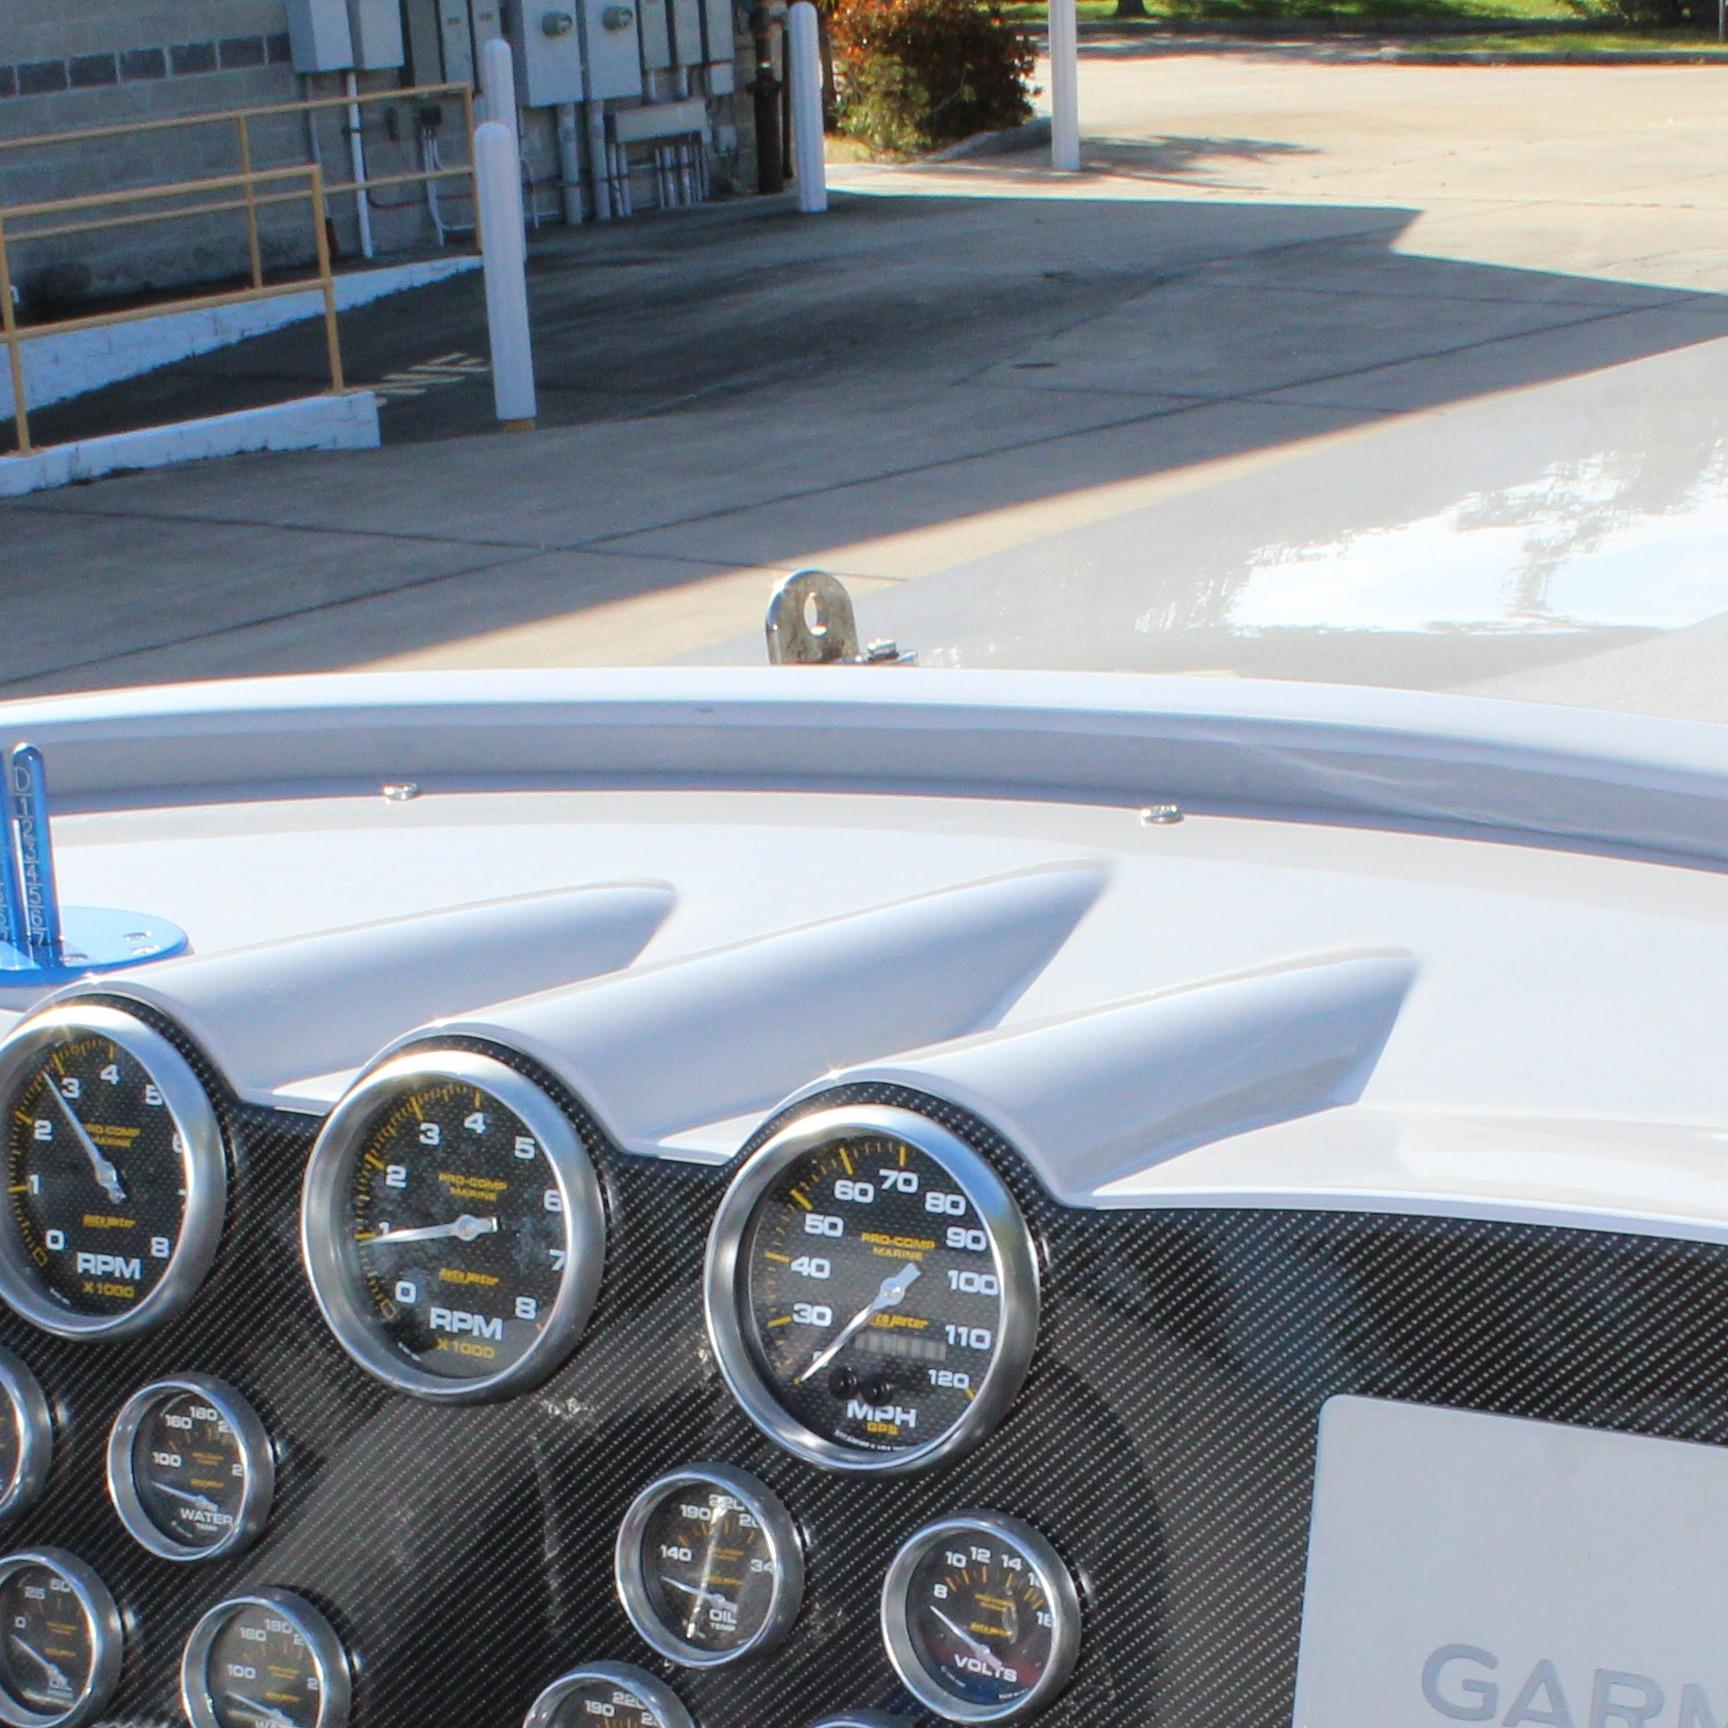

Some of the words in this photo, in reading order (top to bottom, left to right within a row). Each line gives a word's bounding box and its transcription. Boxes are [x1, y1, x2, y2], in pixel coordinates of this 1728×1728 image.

[100, 1064, 119, 1085] 4
[61, 1077, 80, 1099] 3
[145, 1084, 163, 1106] 5
[34, 1120, 52, 1141] 2
[83, 1123, 141, 1137] RO-COMP
[419, 1122, 440, 1146] 3
[464, 1112, 486, 1134] 4
[514, 1136, 535, 1160] 5
[29, 1174, 39, 1195] 1
[385, 1165, 407, 1188] 2
[879, 1169, 918, 1193] 70
[543, 1189, 562, 1212] 6
[834, 1179, 874, 1203] 60
[925, 1192, 966, 1215] 80
[804, 1214, 843, 1237] 50
[46, 1229, 65, 1250] 0
[151, 1237, 170, 1258] 8
[860, 1232, 935, 1250] PRO-COMP
[946, 1226, 987, 1251] 90
[76, 1252, 142, 1280] RPM
[549, 1249, 565, 1271] 7
[790, 1255, 830, 1279] 40
[395, 1281, 417, 1303] 0
[947, 1269, 999, 1296] 100
[515, 1297, 536, 1320] 8
[792, 1303, 832, 1327] 30
[429, 1306, 503, 1340] RPM
[945, 1324, 991, 1350] 110
[928, 1369, 970, 1389] 120
[847, 1400, 916, 1428] MPH
[866, 1421, 899, 1436] GPS
[152, 1451, 181, 1468] 100
[180, 1507, 234, 1525] WATER
[680, 1504, 711, 1521] 190
[660, 1544, 692, 1562] 140
[945, 1550, 967, 1568] 10
[970, 1546, 991, 1563] 12
[1001, 1554, 1022, 1572] 14
[933, 1583, 948, 1599] 8
[14, 1615, 26, 1628] 0
[709, 1607, 737, 1624] OIL
[227, 1664, 256, 1679] 100
[954, 1653, 1018, 1683] VOLTS
[584, 1700, 615, 1718] 190
